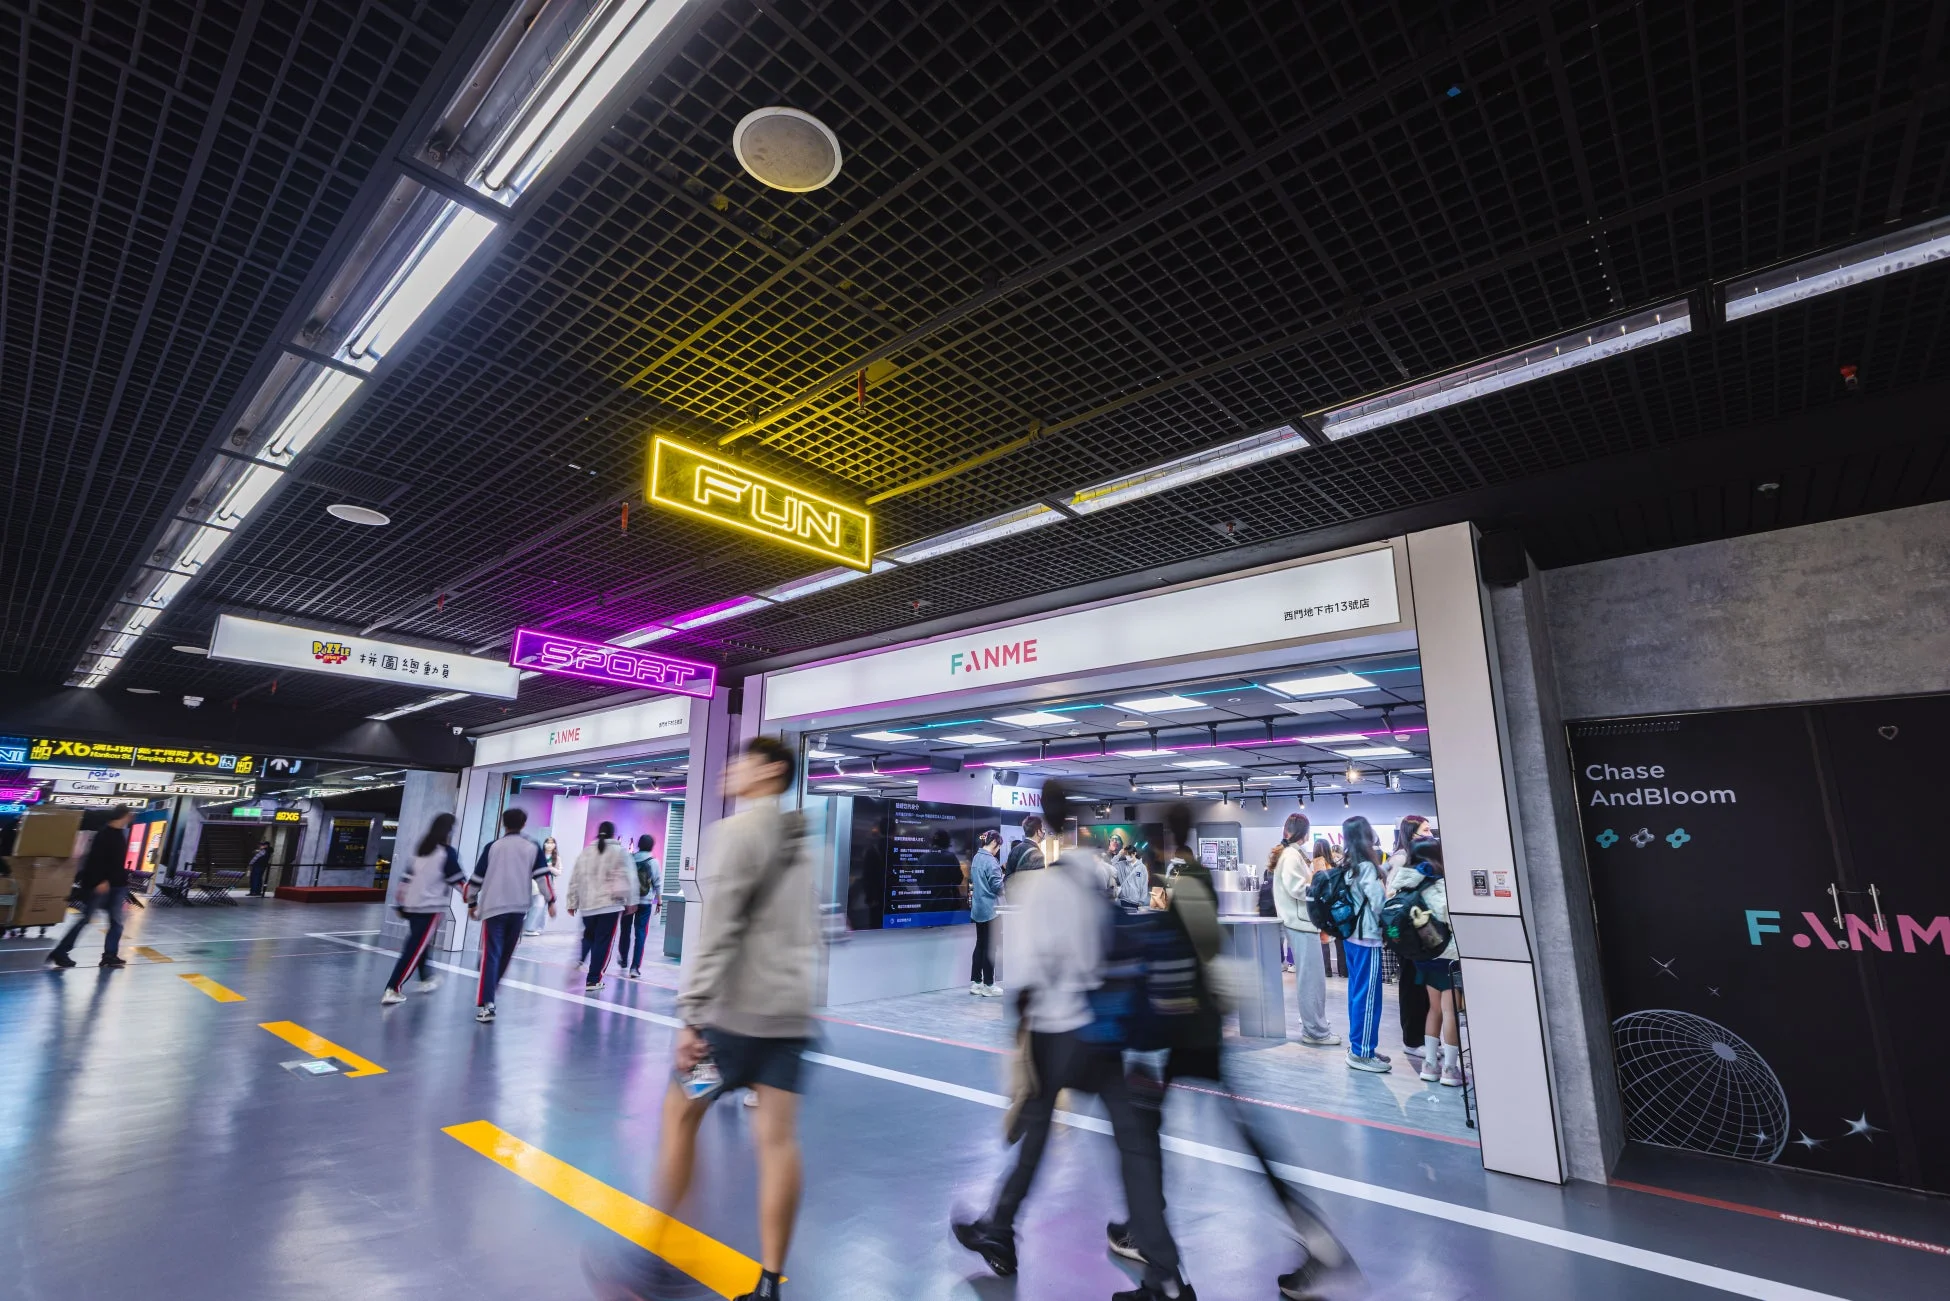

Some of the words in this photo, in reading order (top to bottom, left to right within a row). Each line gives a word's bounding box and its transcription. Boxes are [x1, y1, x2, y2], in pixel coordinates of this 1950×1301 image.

[693, 465, 840, 547] FUN
[1284, 598, 1370, 621] 西門地下市13號店
[312, 641, 351, 657] PUZZLE
[950, 639, 1038, 675] FANME
[360, 652, 449, 678] 拼圖總動員
[541, 641, 695, 687] SPORT
[549, 728, 581, 745] FANME
[53, 741, 91, 757] X6
[188, 751, 219, 766] X5
[1586, 763, 1665, 781] Chase
[1590, 787, 1737, 806] AndBloom
